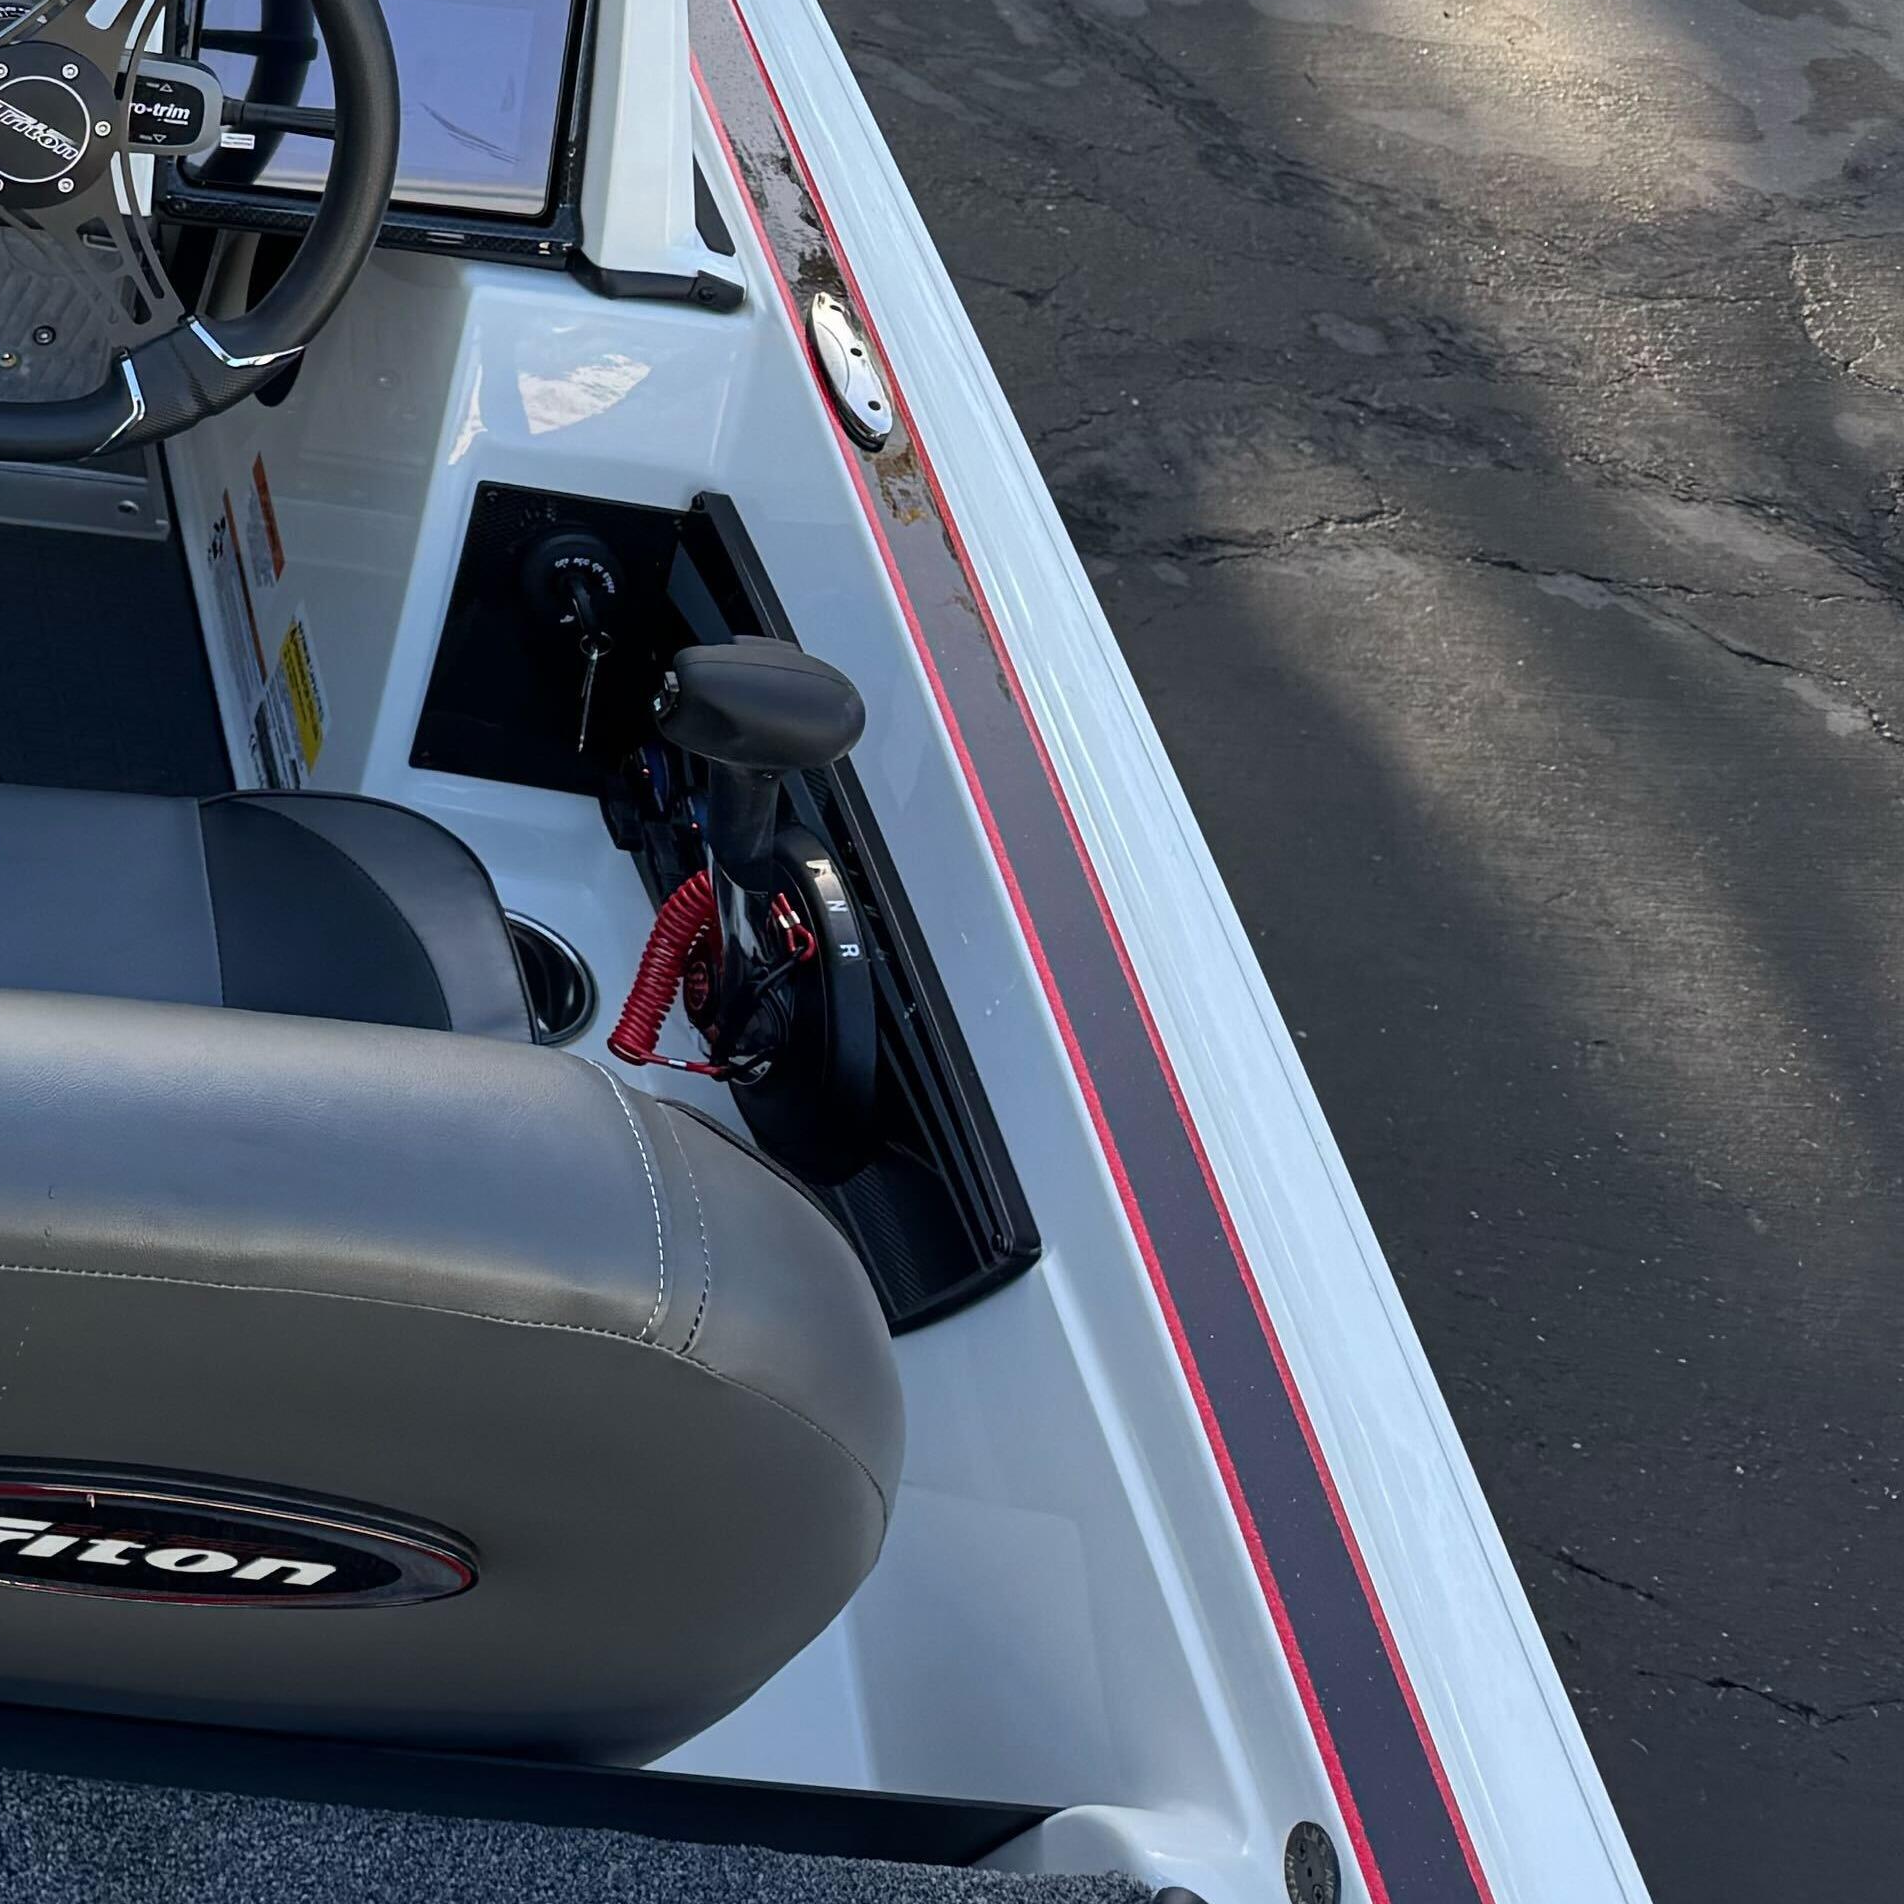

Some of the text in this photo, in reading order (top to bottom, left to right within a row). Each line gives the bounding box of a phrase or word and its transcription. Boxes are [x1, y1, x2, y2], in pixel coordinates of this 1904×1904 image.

[128, 102, 191, 120] ro-trim
[826, 900, 848, 913] N
[839, 943, 860, 958] R
